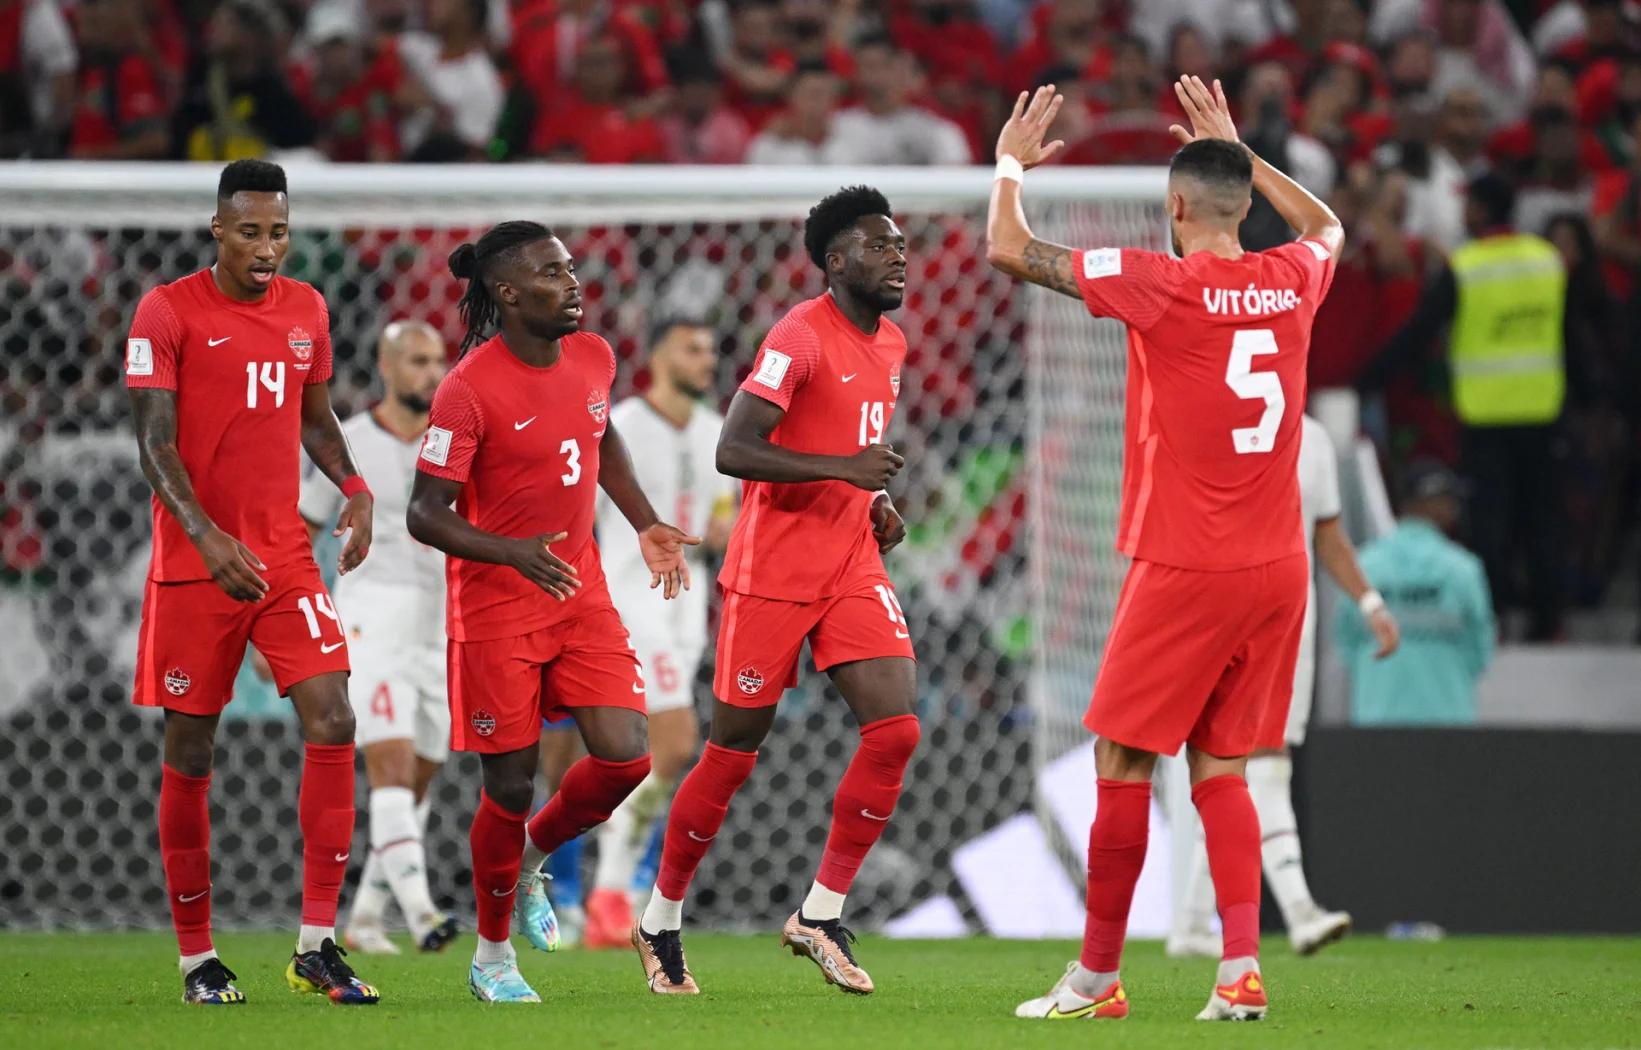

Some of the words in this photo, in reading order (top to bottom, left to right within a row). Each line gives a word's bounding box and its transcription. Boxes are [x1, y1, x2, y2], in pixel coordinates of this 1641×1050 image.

[246, 361, 285, 409] 14
[1225, 329, 1286, 454] 5
[859, 402, 883, 446] 19
[560, 438, 581, 487] 3
[298, 593, 344, 639] 14
[651, 651, 679, 693] 6
[738, 676, 762, 684] CANADA
[371, 682, 394, 722] 4
